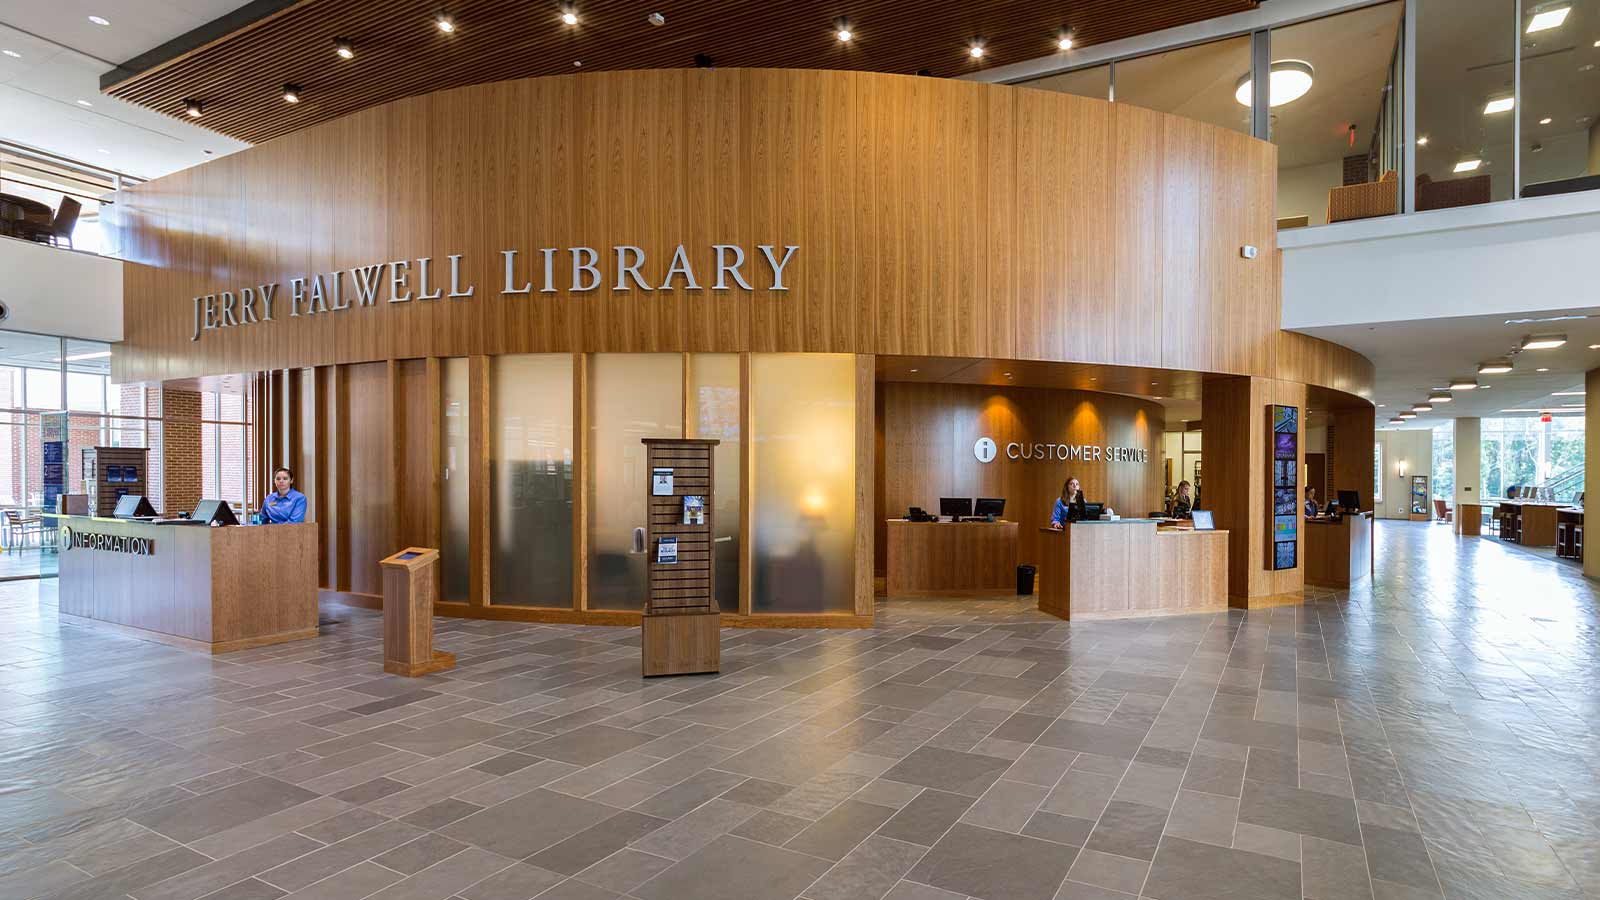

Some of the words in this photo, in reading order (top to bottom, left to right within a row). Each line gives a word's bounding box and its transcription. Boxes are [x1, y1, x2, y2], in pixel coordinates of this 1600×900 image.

[191, 282, 280, 342] JERRY
[289, 254, 475, 317] FALWELL
[500, 243, 800, 294] LIBRARY
[1006, 442, 1101, 461] CUSTOMER
[1105, 446, 1148, 463] SERVICE
[73, 532, 150, 556] INFORMATION
